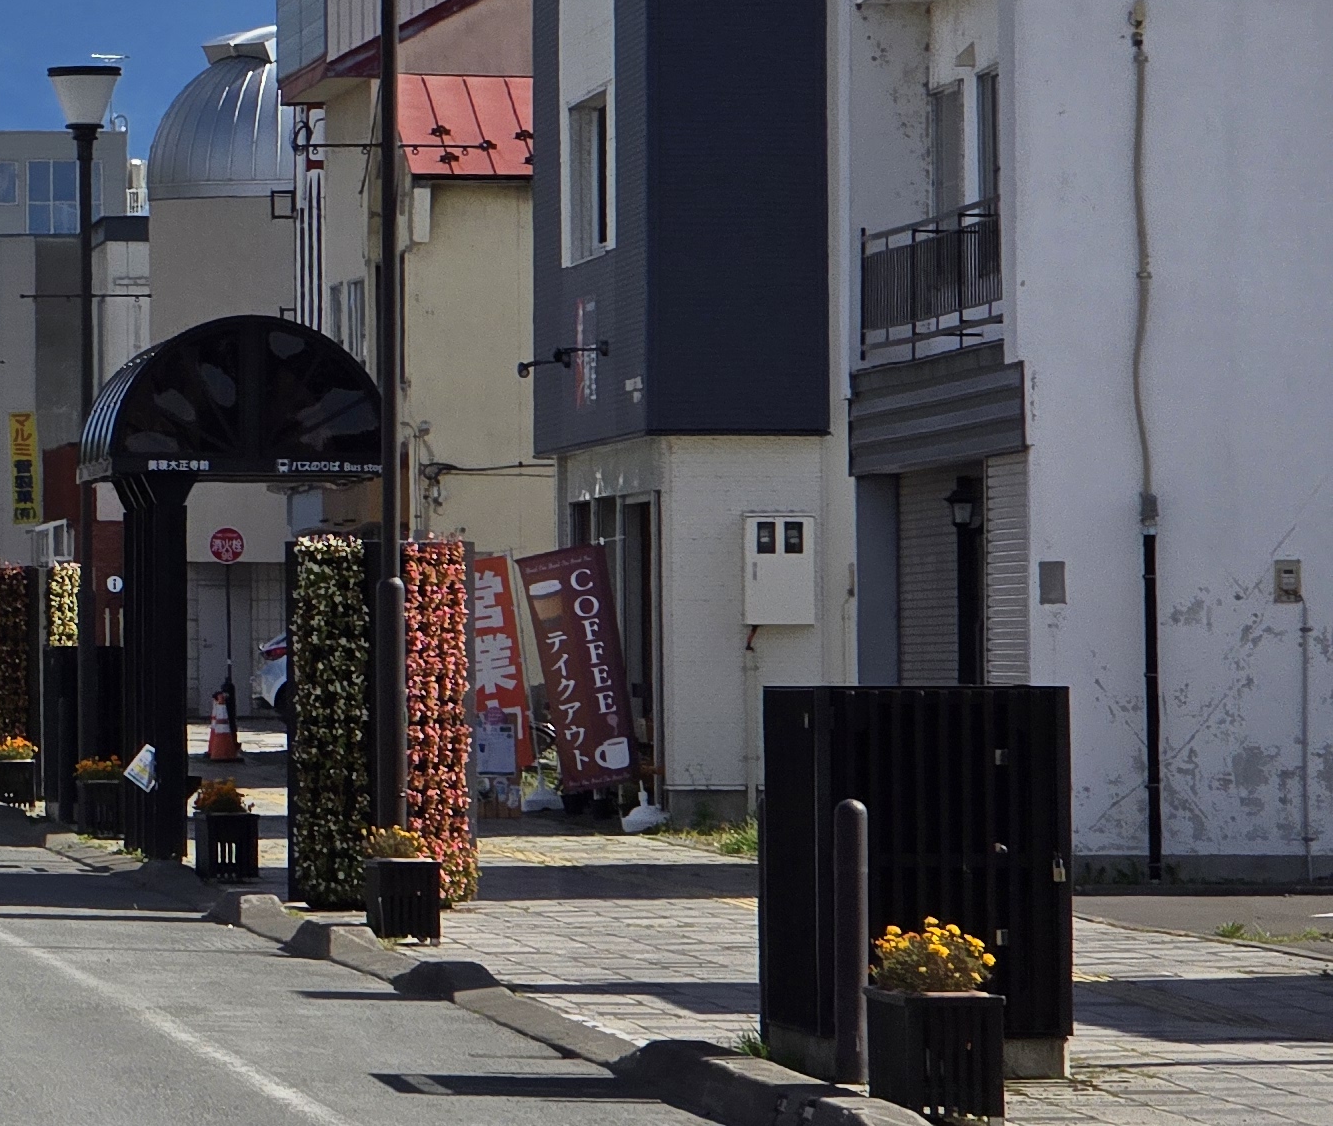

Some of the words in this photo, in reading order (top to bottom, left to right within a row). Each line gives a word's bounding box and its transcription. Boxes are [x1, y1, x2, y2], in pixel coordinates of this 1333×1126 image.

[343, 461, 362, 472] Bus
[211, 538, 243, 554] 消火栓
[570, 568, 617, 714] COFFEE
[545, 631, 590, 771] テイクアウト
